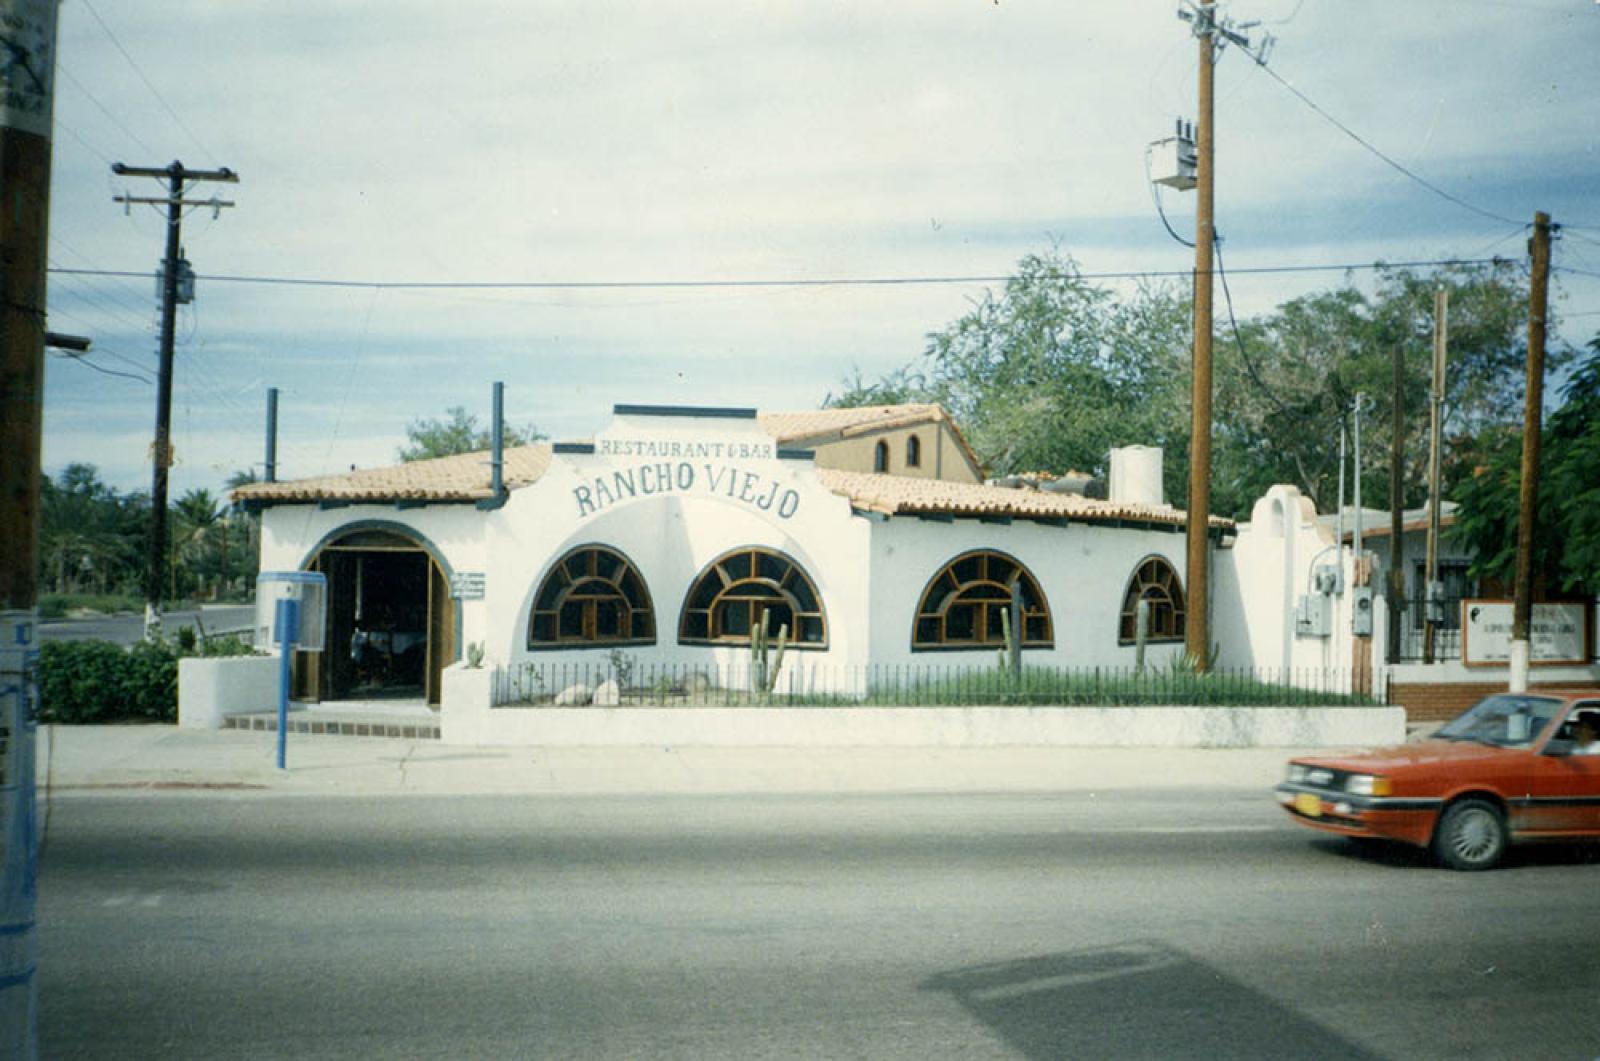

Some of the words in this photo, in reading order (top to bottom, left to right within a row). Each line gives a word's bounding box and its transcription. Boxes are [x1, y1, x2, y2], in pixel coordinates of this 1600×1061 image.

[601, 440, 724, 458] RESTAURANT
[740, 443, 771, 459] BAR
[573, 462, 695, 517] RANCHO
[704, 464, 800, 519] VIEJO
